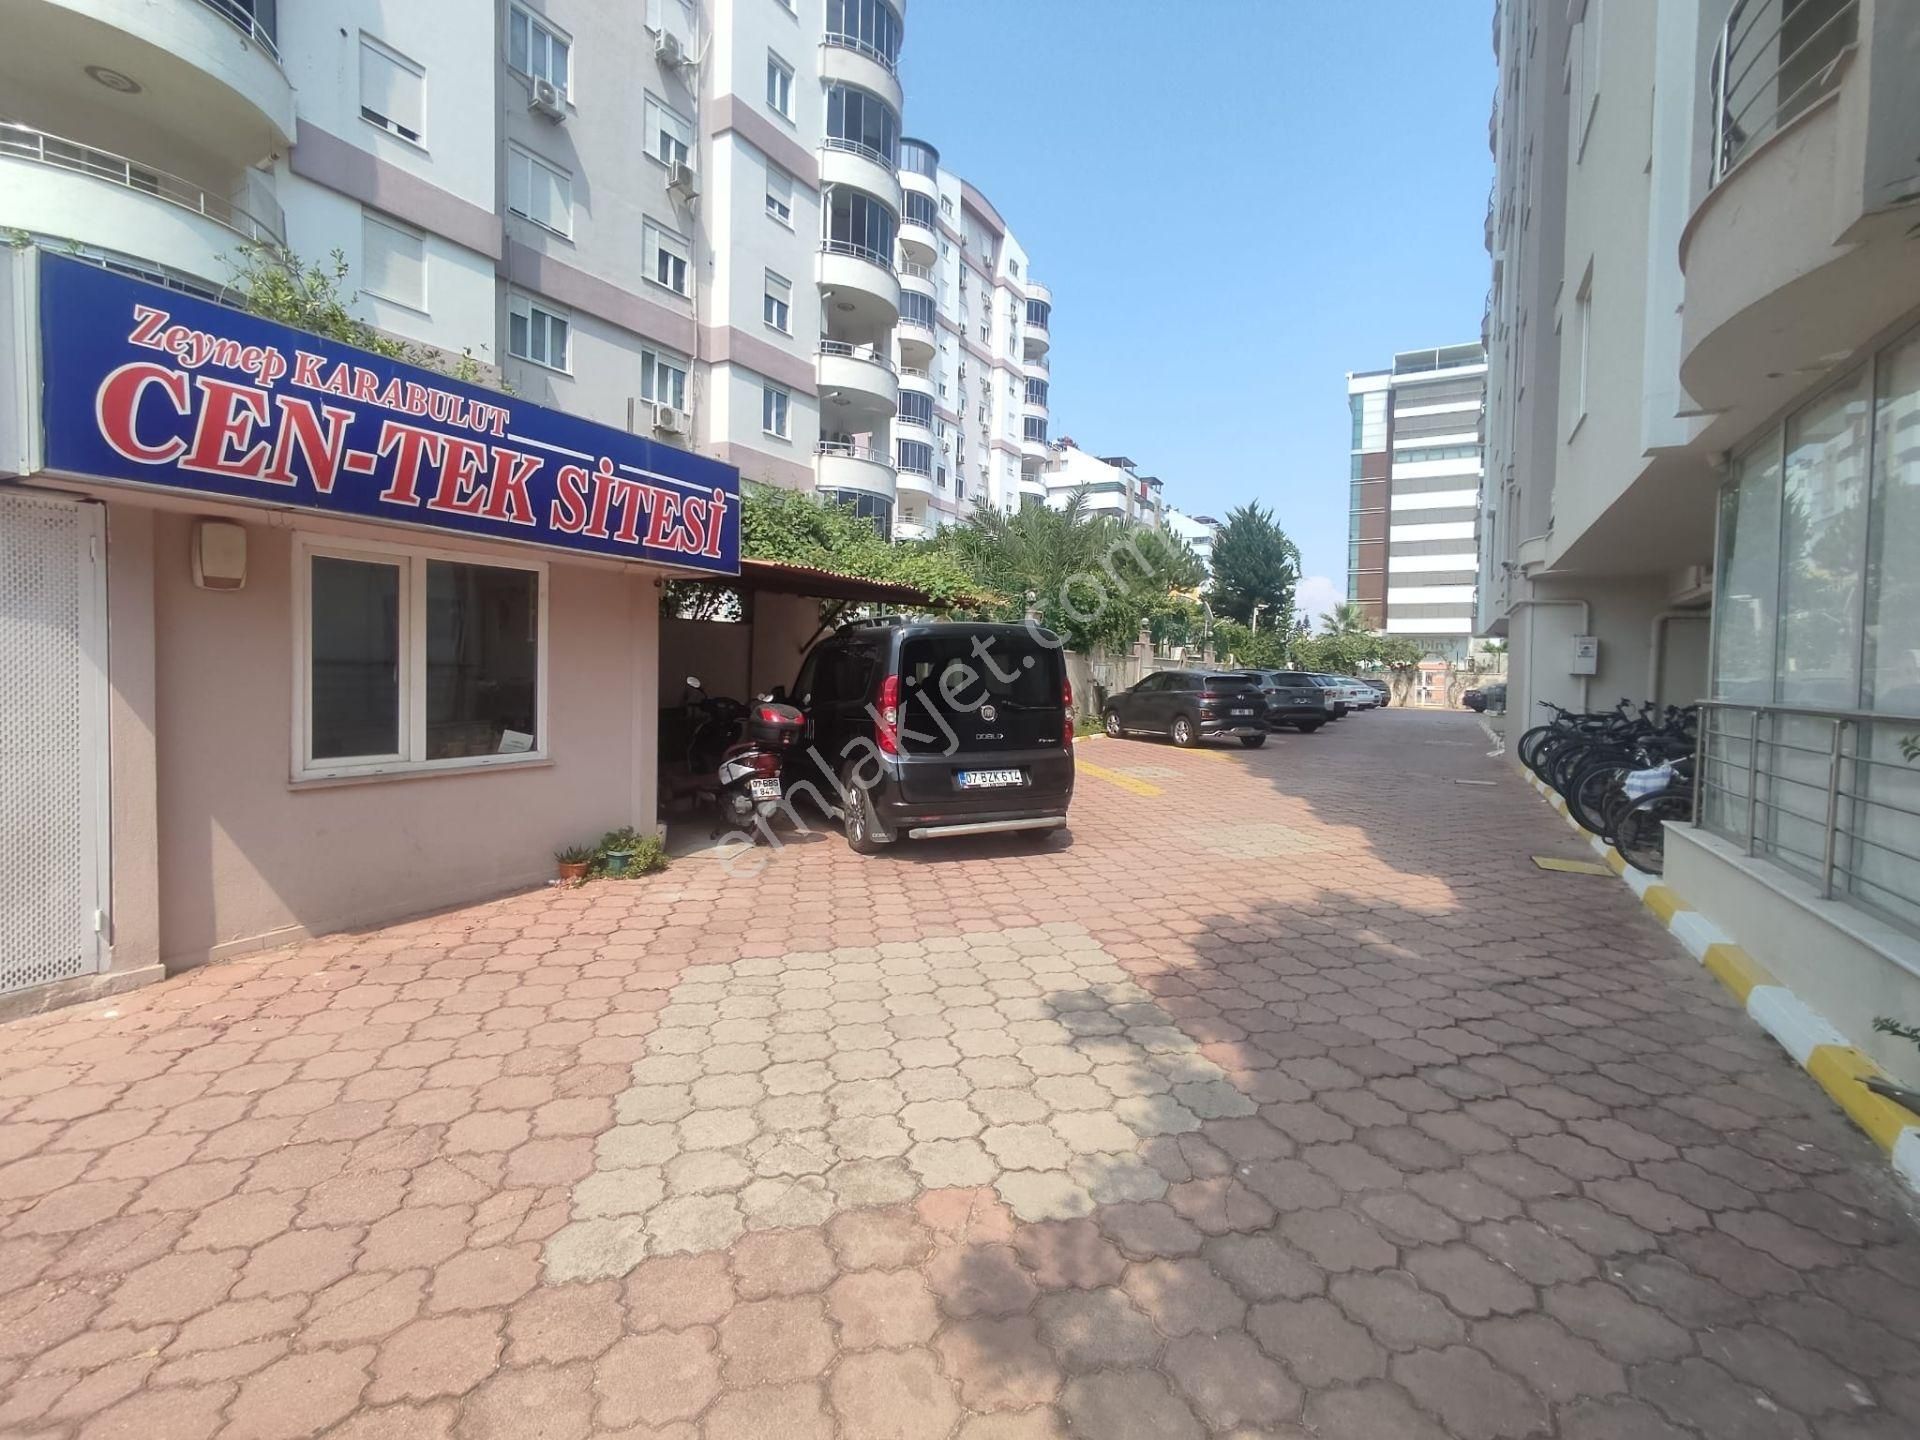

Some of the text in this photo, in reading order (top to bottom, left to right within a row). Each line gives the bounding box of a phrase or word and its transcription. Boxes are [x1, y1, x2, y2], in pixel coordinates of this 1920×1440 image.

[128, 304, 510, 437] Zeynep KARABULUT
[96, 361, 728, 559] CEN-TEK SİTESİ
[965, 773, 978, 784] 07
[980, 771, 1000, 783] BZK
